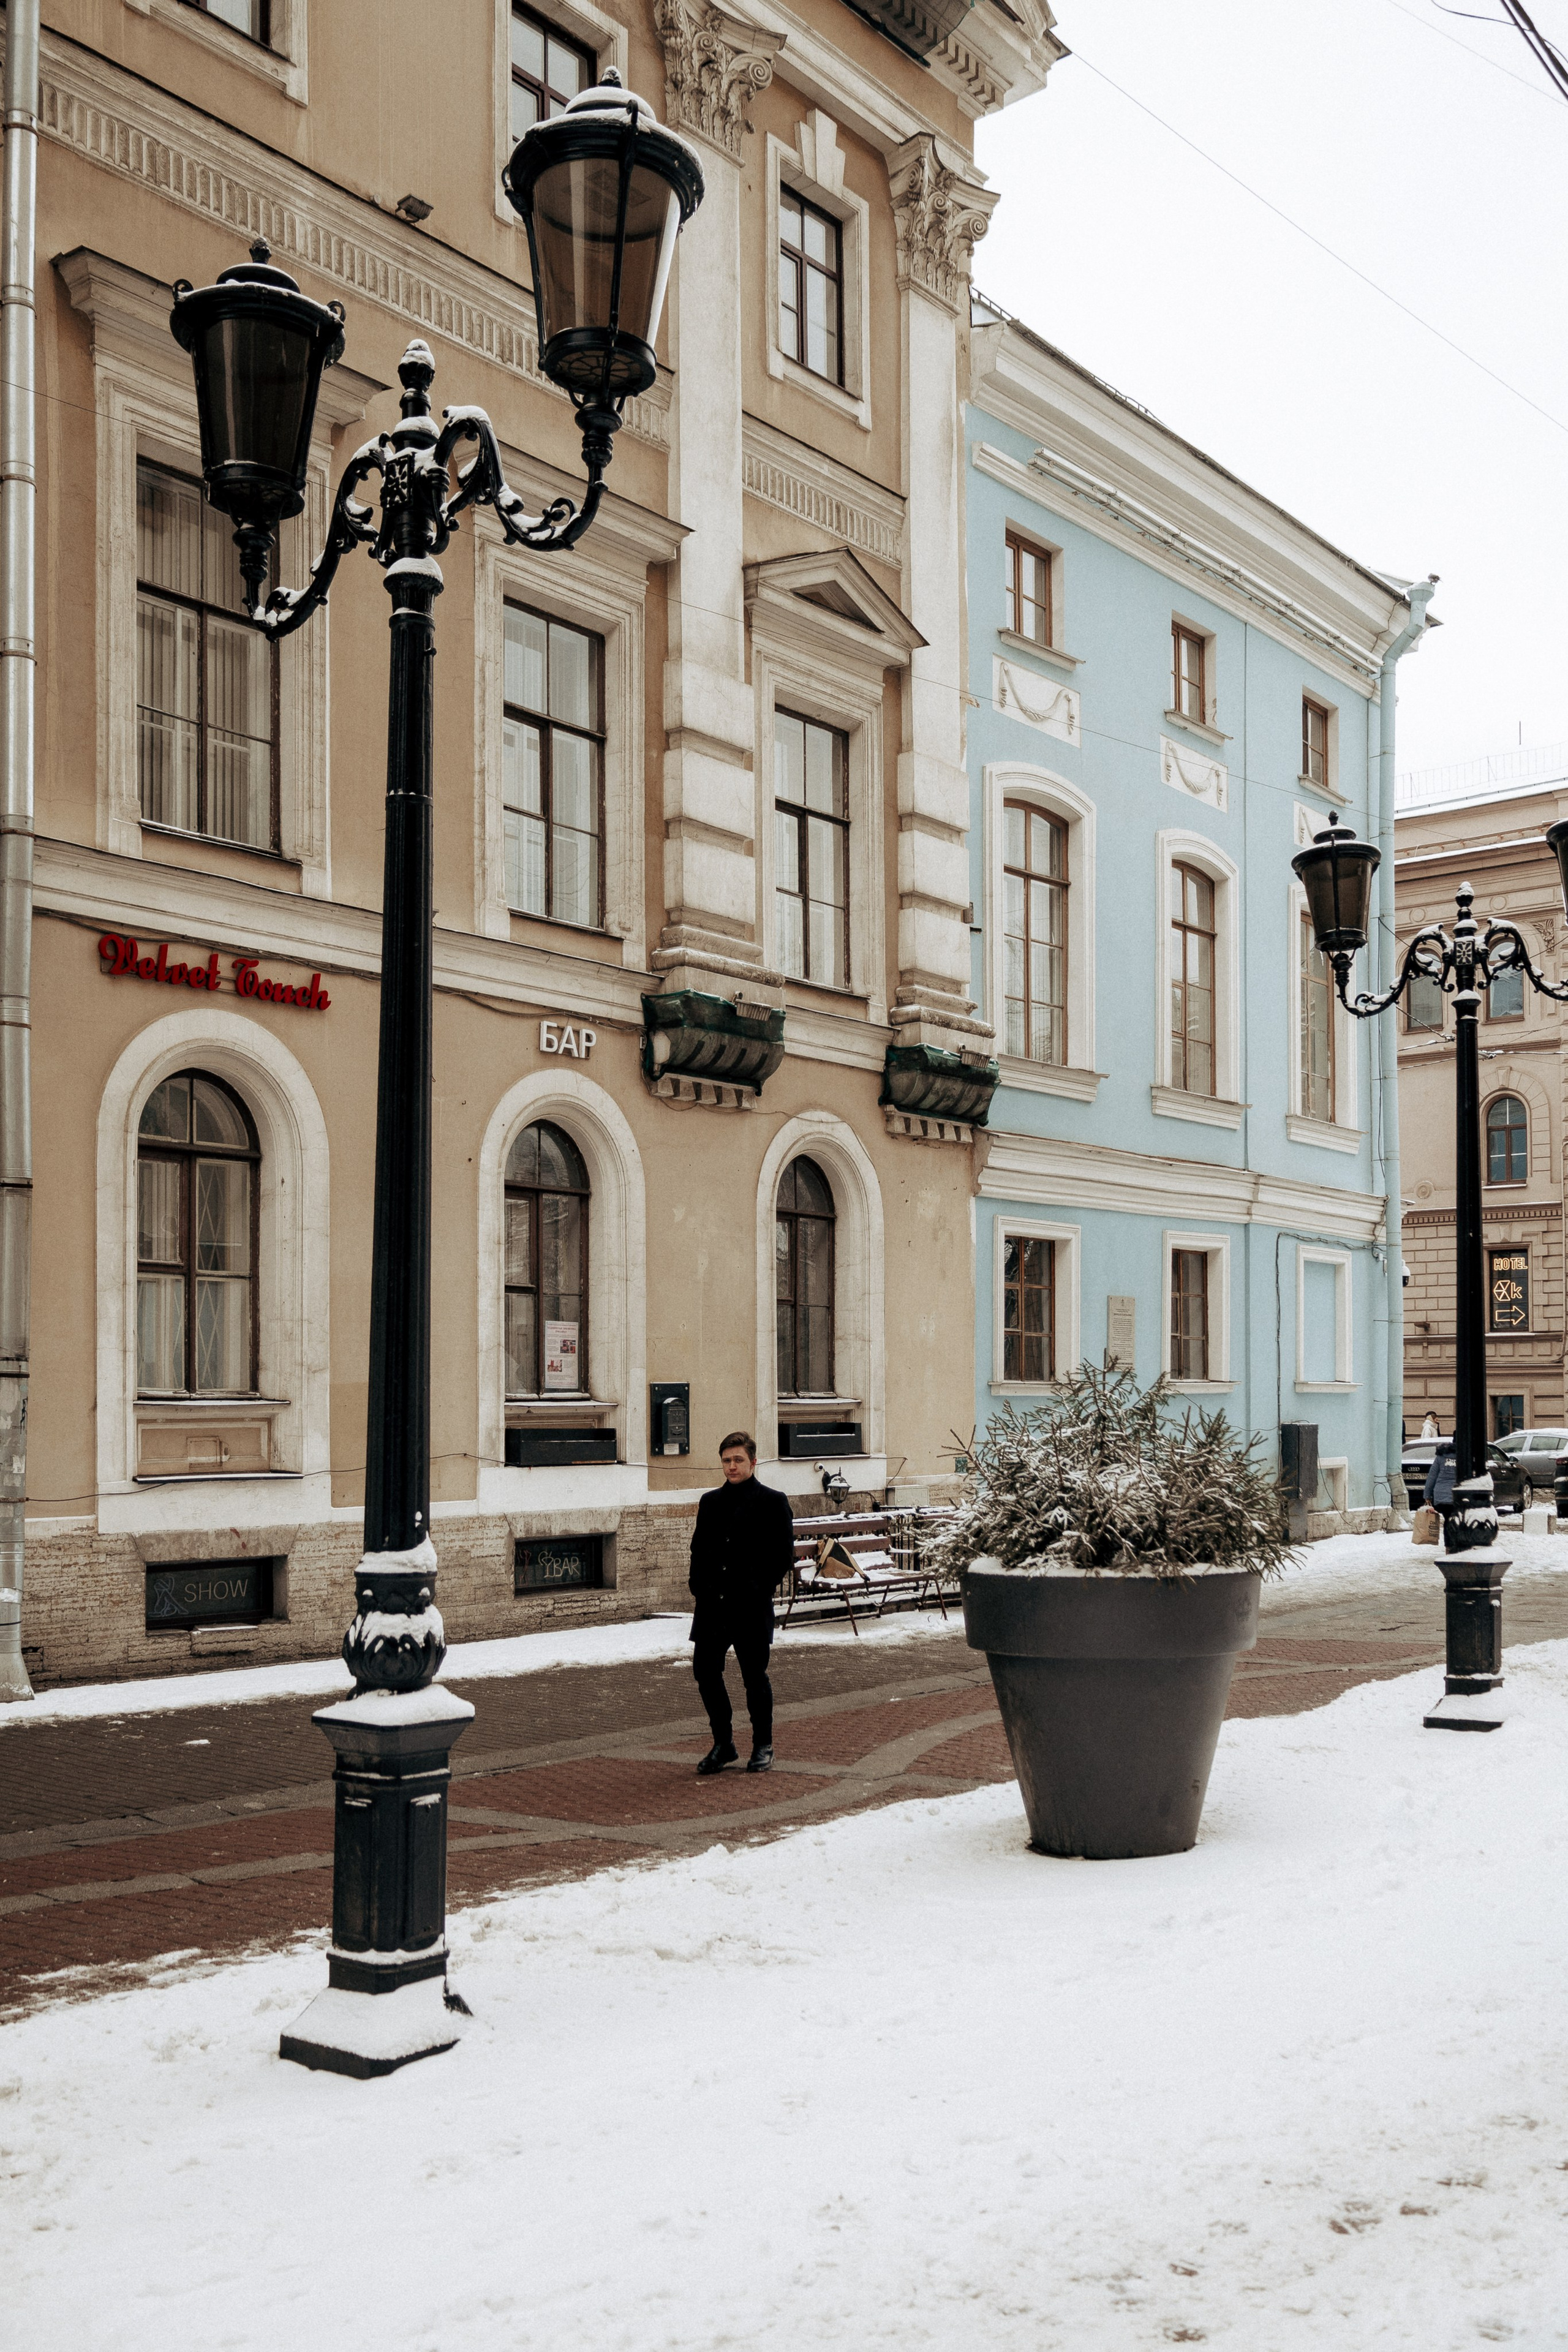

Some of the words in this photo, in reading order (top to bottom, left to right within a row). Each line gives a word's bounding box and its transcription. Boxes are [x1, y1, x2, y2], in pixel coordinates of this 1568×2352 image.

[98, 933, 221, 991] Velvet
[232, 957, 332, 1011] Touch
[540, 1020, 597, 1058] БАР
[1493, 1257, 1528, 1270] HOTEL
[553, 1556, 580, 1578] BAR
[184, 1578, 249, 1603] SHOW
